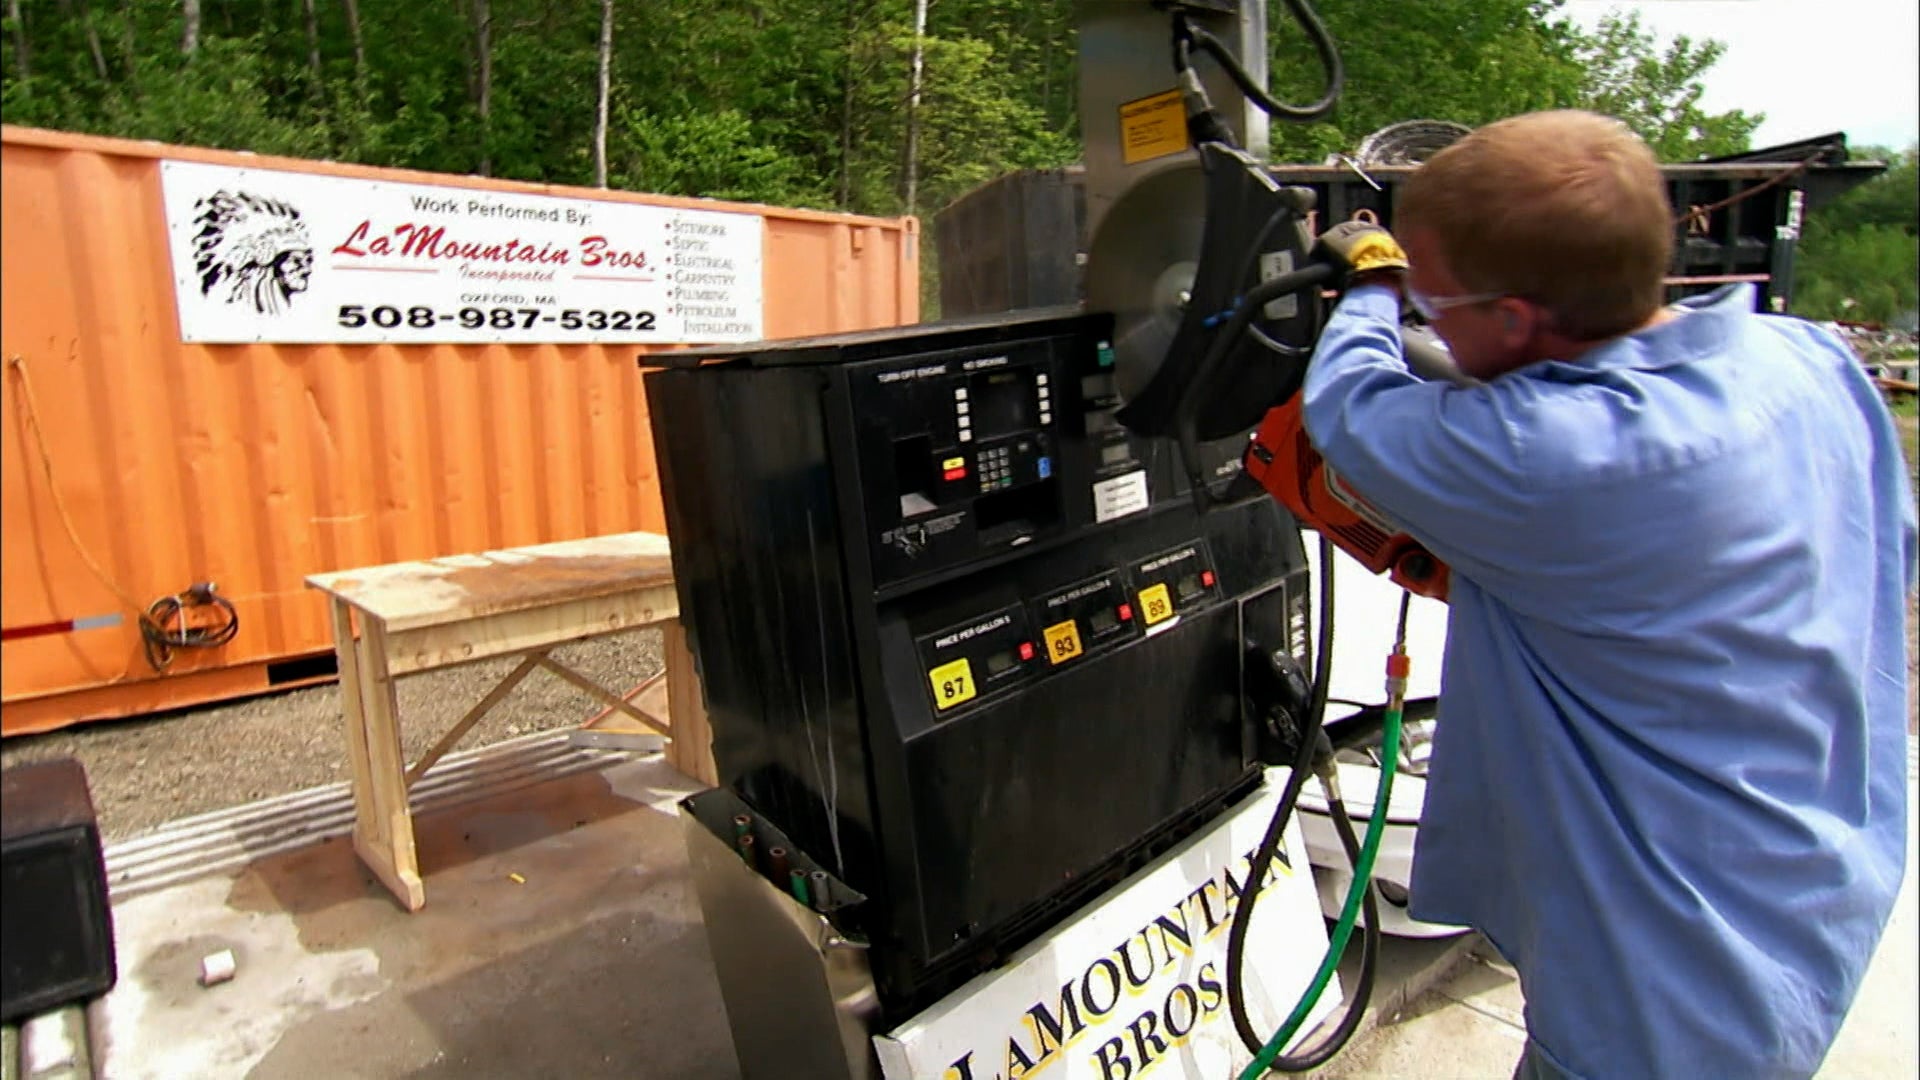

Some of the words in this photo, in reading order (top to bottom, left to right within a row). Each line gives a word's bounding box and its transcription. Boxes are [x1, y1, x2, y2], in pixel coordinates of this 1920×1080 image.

[411, 196, 459, 214] Work
[468, 202, 559, 222] Performed
[567, 209, 592, 227] By:
[331, 220, 570, 264] LaMountain
[580, 236, 656, 272] Bros.
[459, 262, 556, 282] Incorporated
[535, 295, 556, 305] MA
[338, 305, 656, 331] 508-987-5322
[936, 633, 958, 649] PRICE
[959, 627, 975, 640] PER
[975, 617, 1004, 634] GALLON
[1055, 636, 1075, 656] 93
[943, 677, 965, 699] 87
[1094, 962, 1223, 1080] BROS
